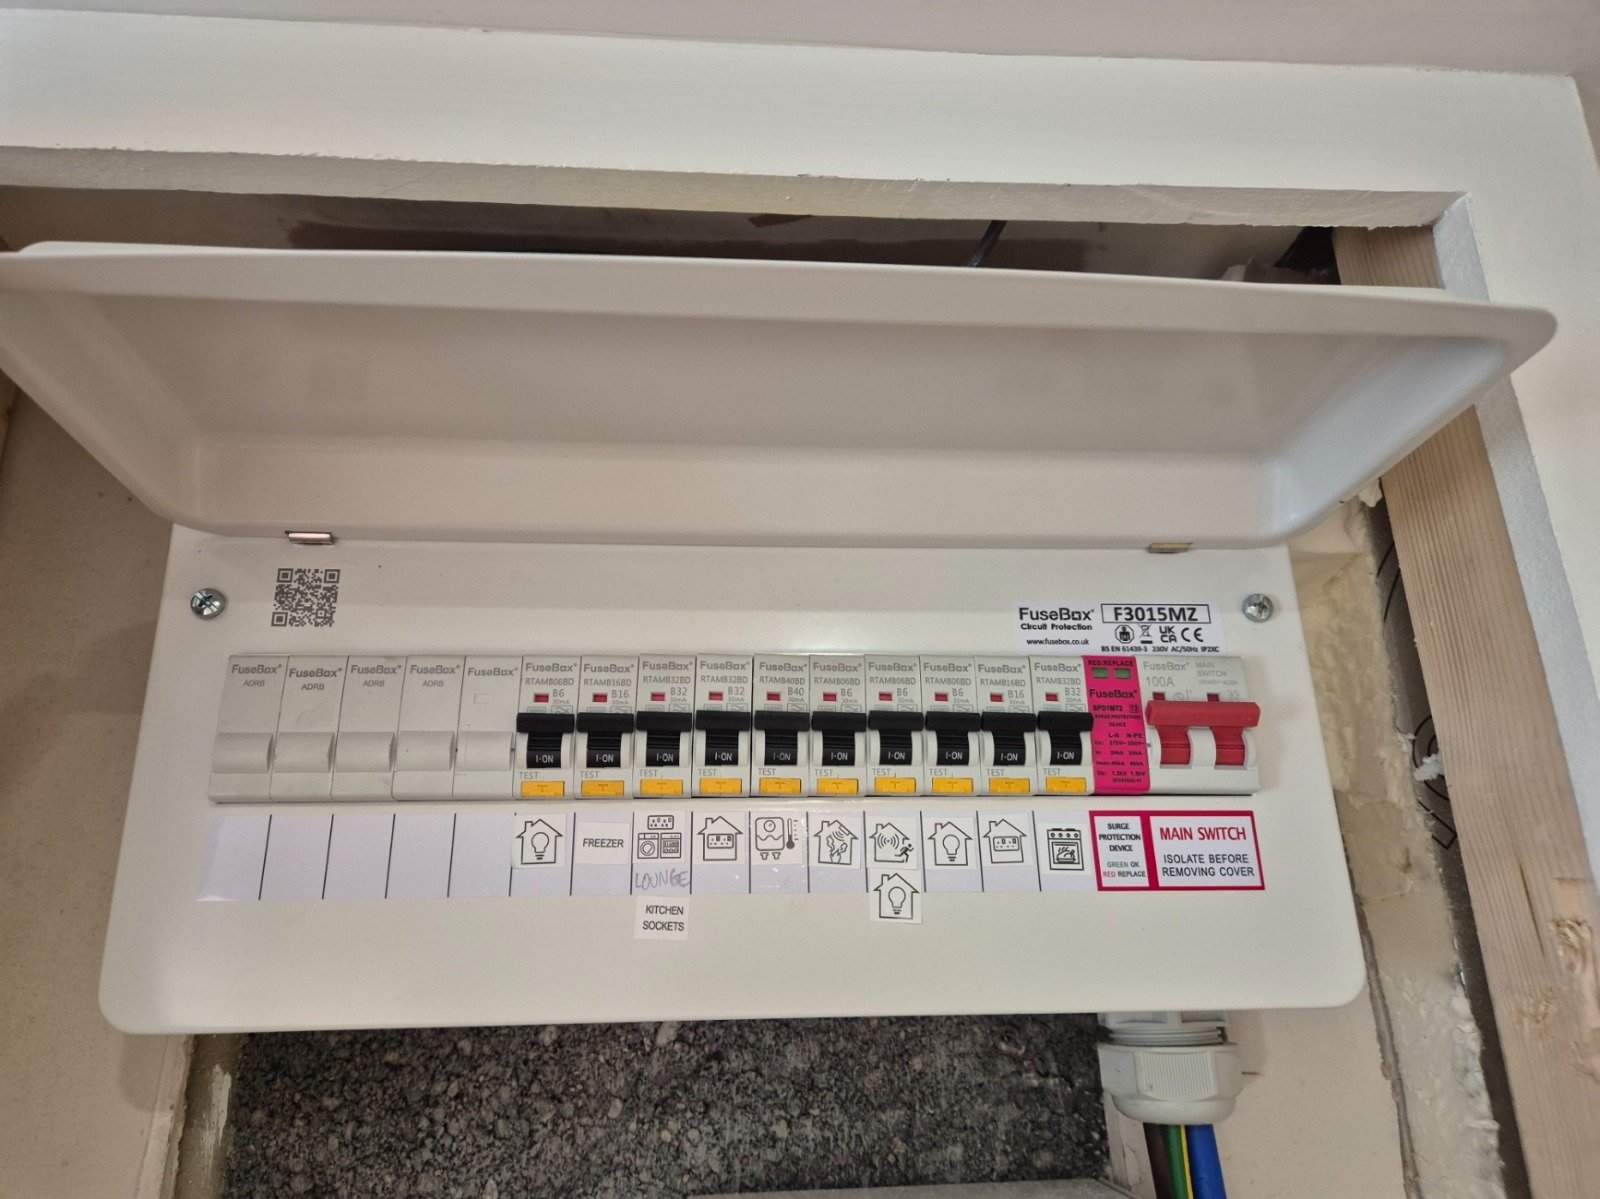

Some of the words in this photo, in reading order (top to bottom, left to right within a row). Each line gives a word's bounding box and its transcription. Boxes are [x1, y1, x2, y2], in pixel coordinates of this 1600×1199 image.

[1114, 606, 1198, 622] F3015MZ
[1026, 638, 1089, 646] www.fusebox.co.uk
[525, 677, 574, 686] RTAMB06BD
[583, 678, 632, 687] RTAMB16BD
[643, 676, 691, 684] RTAMB32BD
[701, 676, 748, 684] RTAMB32BD
[760, 676, 805, 685] RTAMB40BD
[814, 677, 860, 685] RTAMB06BD
[869, 677, 916, 685] RTAMB06BD
[925, 677, 971, 685] RTAMB06BD
[980, 678, 1026, 687] RTAMB16BD
[1036, 677, 1081, 685] RTAMB32BD
[1146, 676, 1175, 687] 100A
[301, 683, 324, 691] ADRB
[553, 689, 565, 697] B6
[611, 690, 629, 699] B16
[670, 687, 687, 696] B32
[728, 687, 745, 696] B32
[787, 687, 805, 696] B40
[840, 688, 852, 697] B6
[896, 688, 908, 696] B6
[952, 688, 964, 696] B6
[1008, 690, 1025, 699] B16
[1065, 687, 1081, 696] B32
[519, 771, 539, 779] TEST
[639, 769, 658, 777] TEST
[698, 769, 717, 777] TEST
[758, 768, 776, 776] TEST
[814, 768, 833, 776] TEST
[872, 768, 890, 776] TEST
[929, 768, 948, 776] TEST
[986, 768, 1005, 776] TEST
[1043, 768, 1061, 776] TEST
[1160, 827, 1193, 840] MAIN
[1198, 827, 1246, 840] SWITCH
[583, 838, 624, 848] FREEZER
[1164, 854, 1205, 863] ISOLATE
[1208, 854, 1249, 863] BEFORE
[1162, 867, 1216, 877] REMOVING
[1219, 867, 1254, 877] COVER
[635, 869, 690, 890] LOUNGE
[646, 905, 684, 915] KITCHEN
[642, 921, 684, 931] SOCKETS
